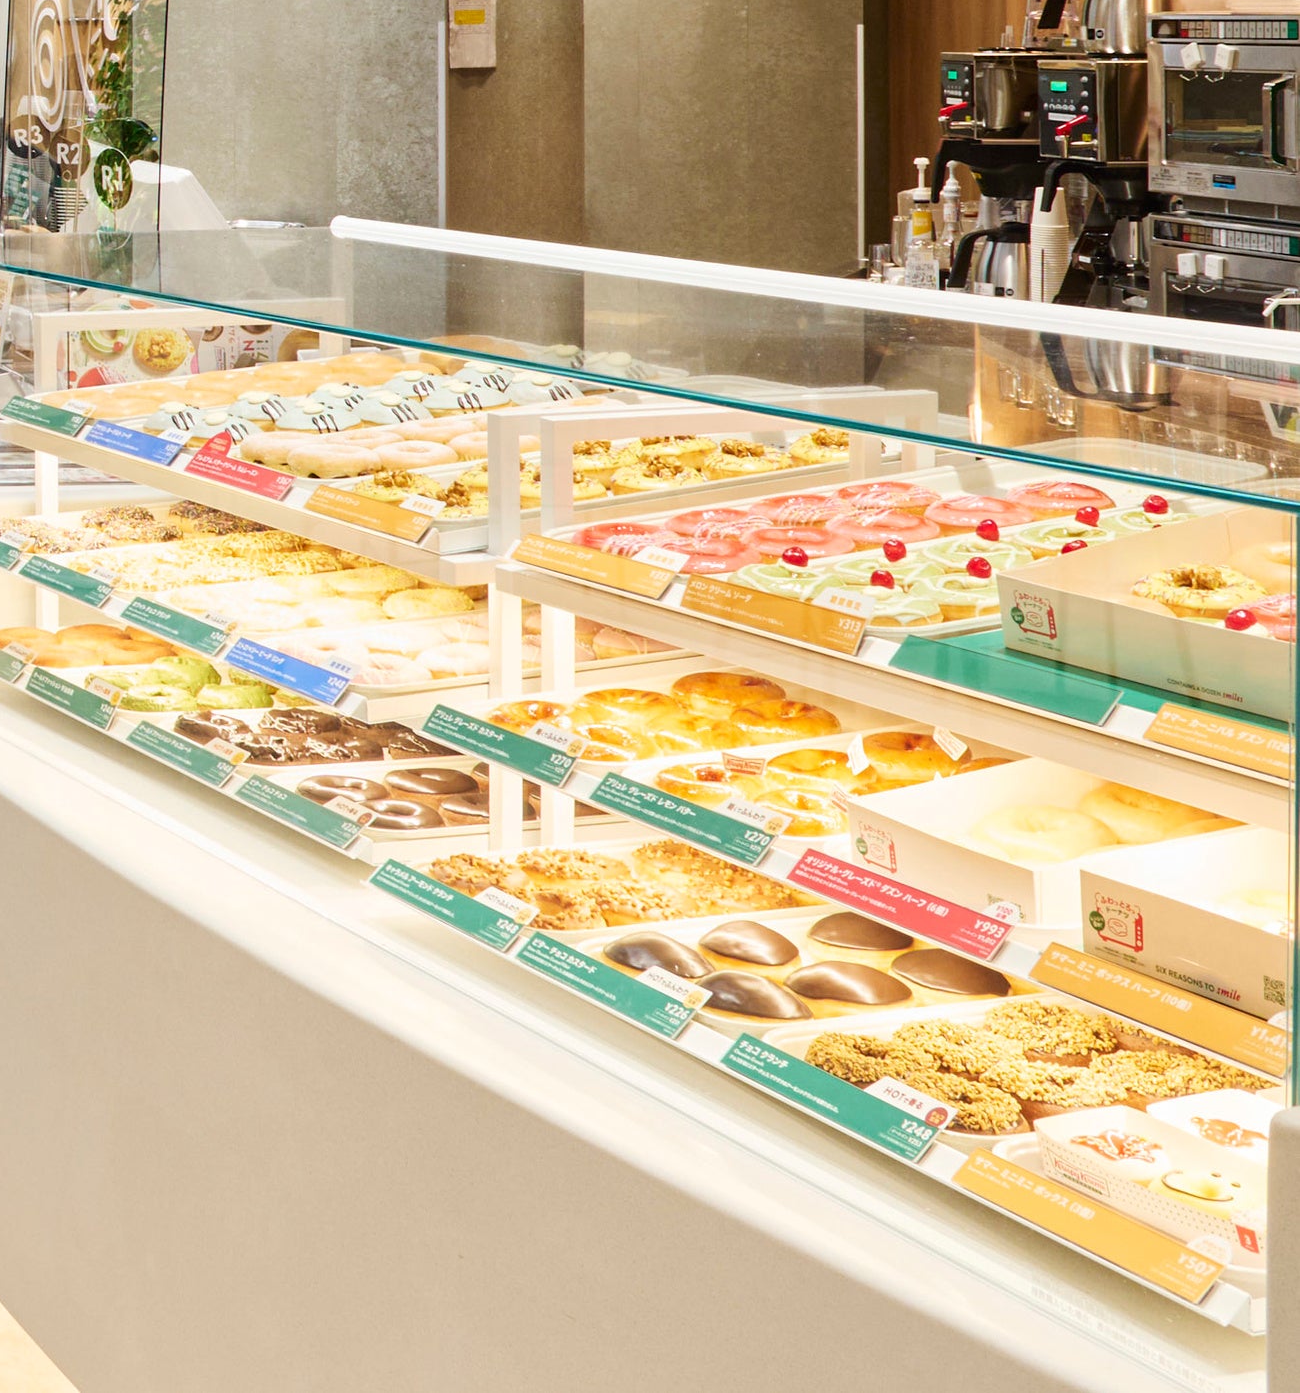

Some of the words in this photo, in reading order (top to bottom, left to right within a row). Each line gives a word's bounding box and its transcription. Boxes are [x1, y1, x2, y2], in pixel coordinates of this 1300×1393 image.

[14, 125, 43, 147] R3
[56, 142, 81, 165] R2
[101, 165, 124, 191] R1
[838, 618, 862, 633] ¥313
[1222, 690, 1243, 703] smiles
[550, 753, 572, 768] ¥270
[744, 830, 771, 846] ¥270
[496, 918, 520, 934] ¥248
[974, 919, 1006, 938] ¥993
[1156, 965, 1167, 975] SIX
[1168, 969, 1204, 989] REASONS
[1204, 982, 1215, 992] TO
[1217, 987, 1241, 1002] smile
[665, 1001, 689, 1019] ¥226
[738, 1039, 760, 1056] チョコ
[760, 1050, 789, 1069] クランチ
[901, 1118, 934, 1141] ¥248
[1178, 1252, 1217, 1277] ¥507
